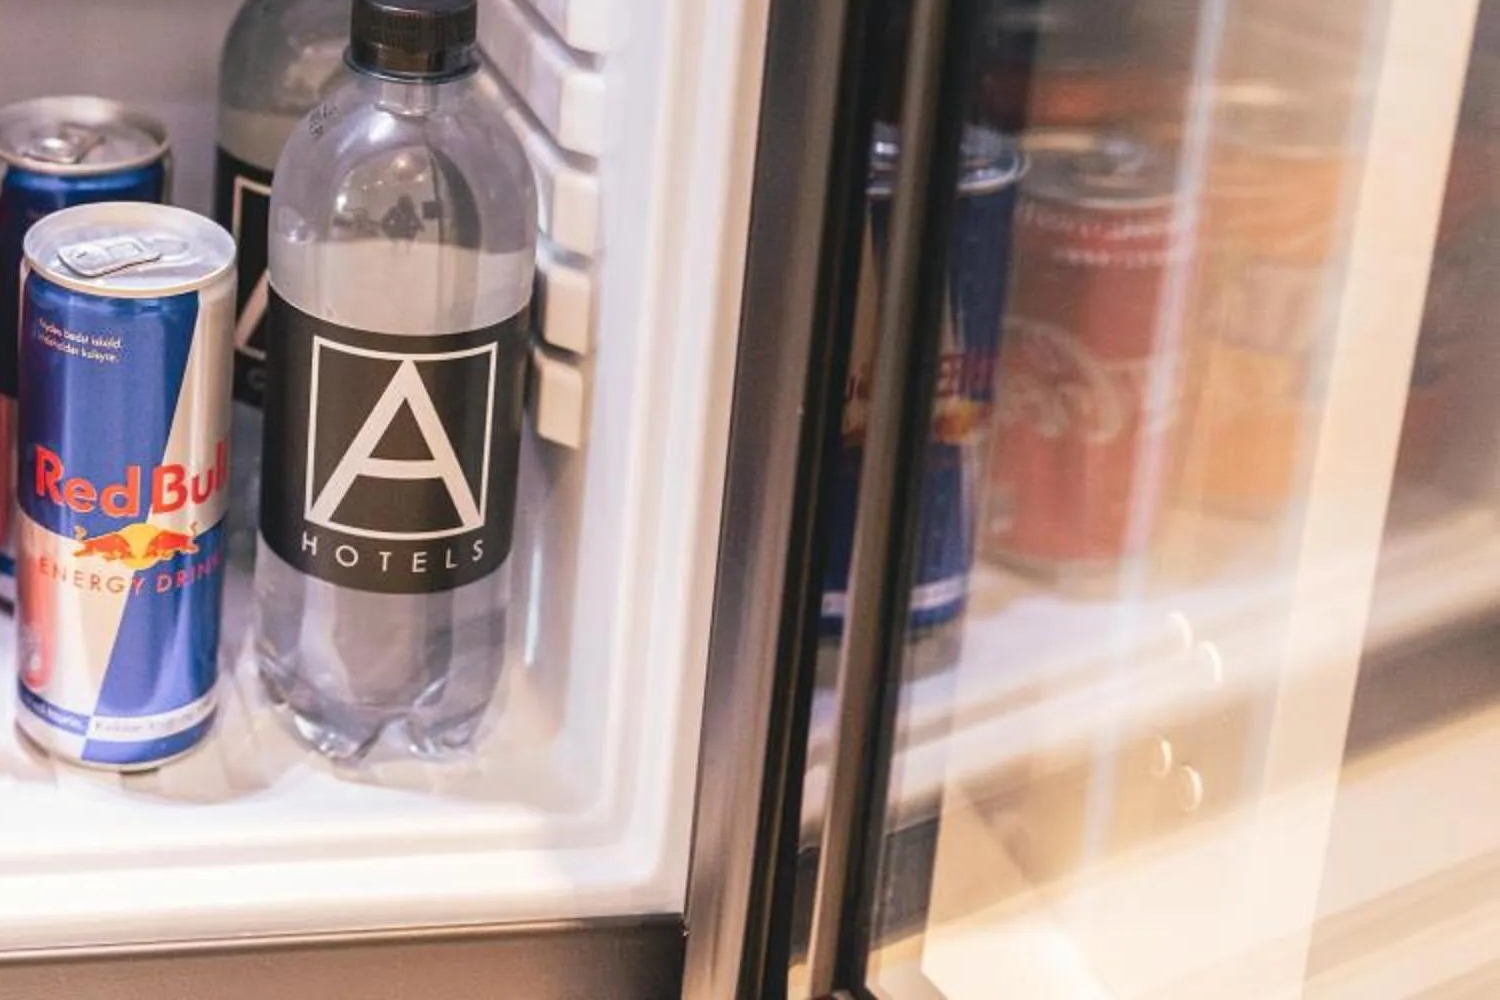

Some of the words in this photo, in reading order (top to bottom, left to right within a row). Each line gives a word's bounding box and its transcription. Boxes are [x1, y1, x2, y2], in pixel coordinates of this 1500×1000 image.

[310, 356, 482, 530] A
[34, 443, 141, 518] Red
[40, 555, 145, 596] ENERGY
[302, 531, 484, 573] HOTELS
